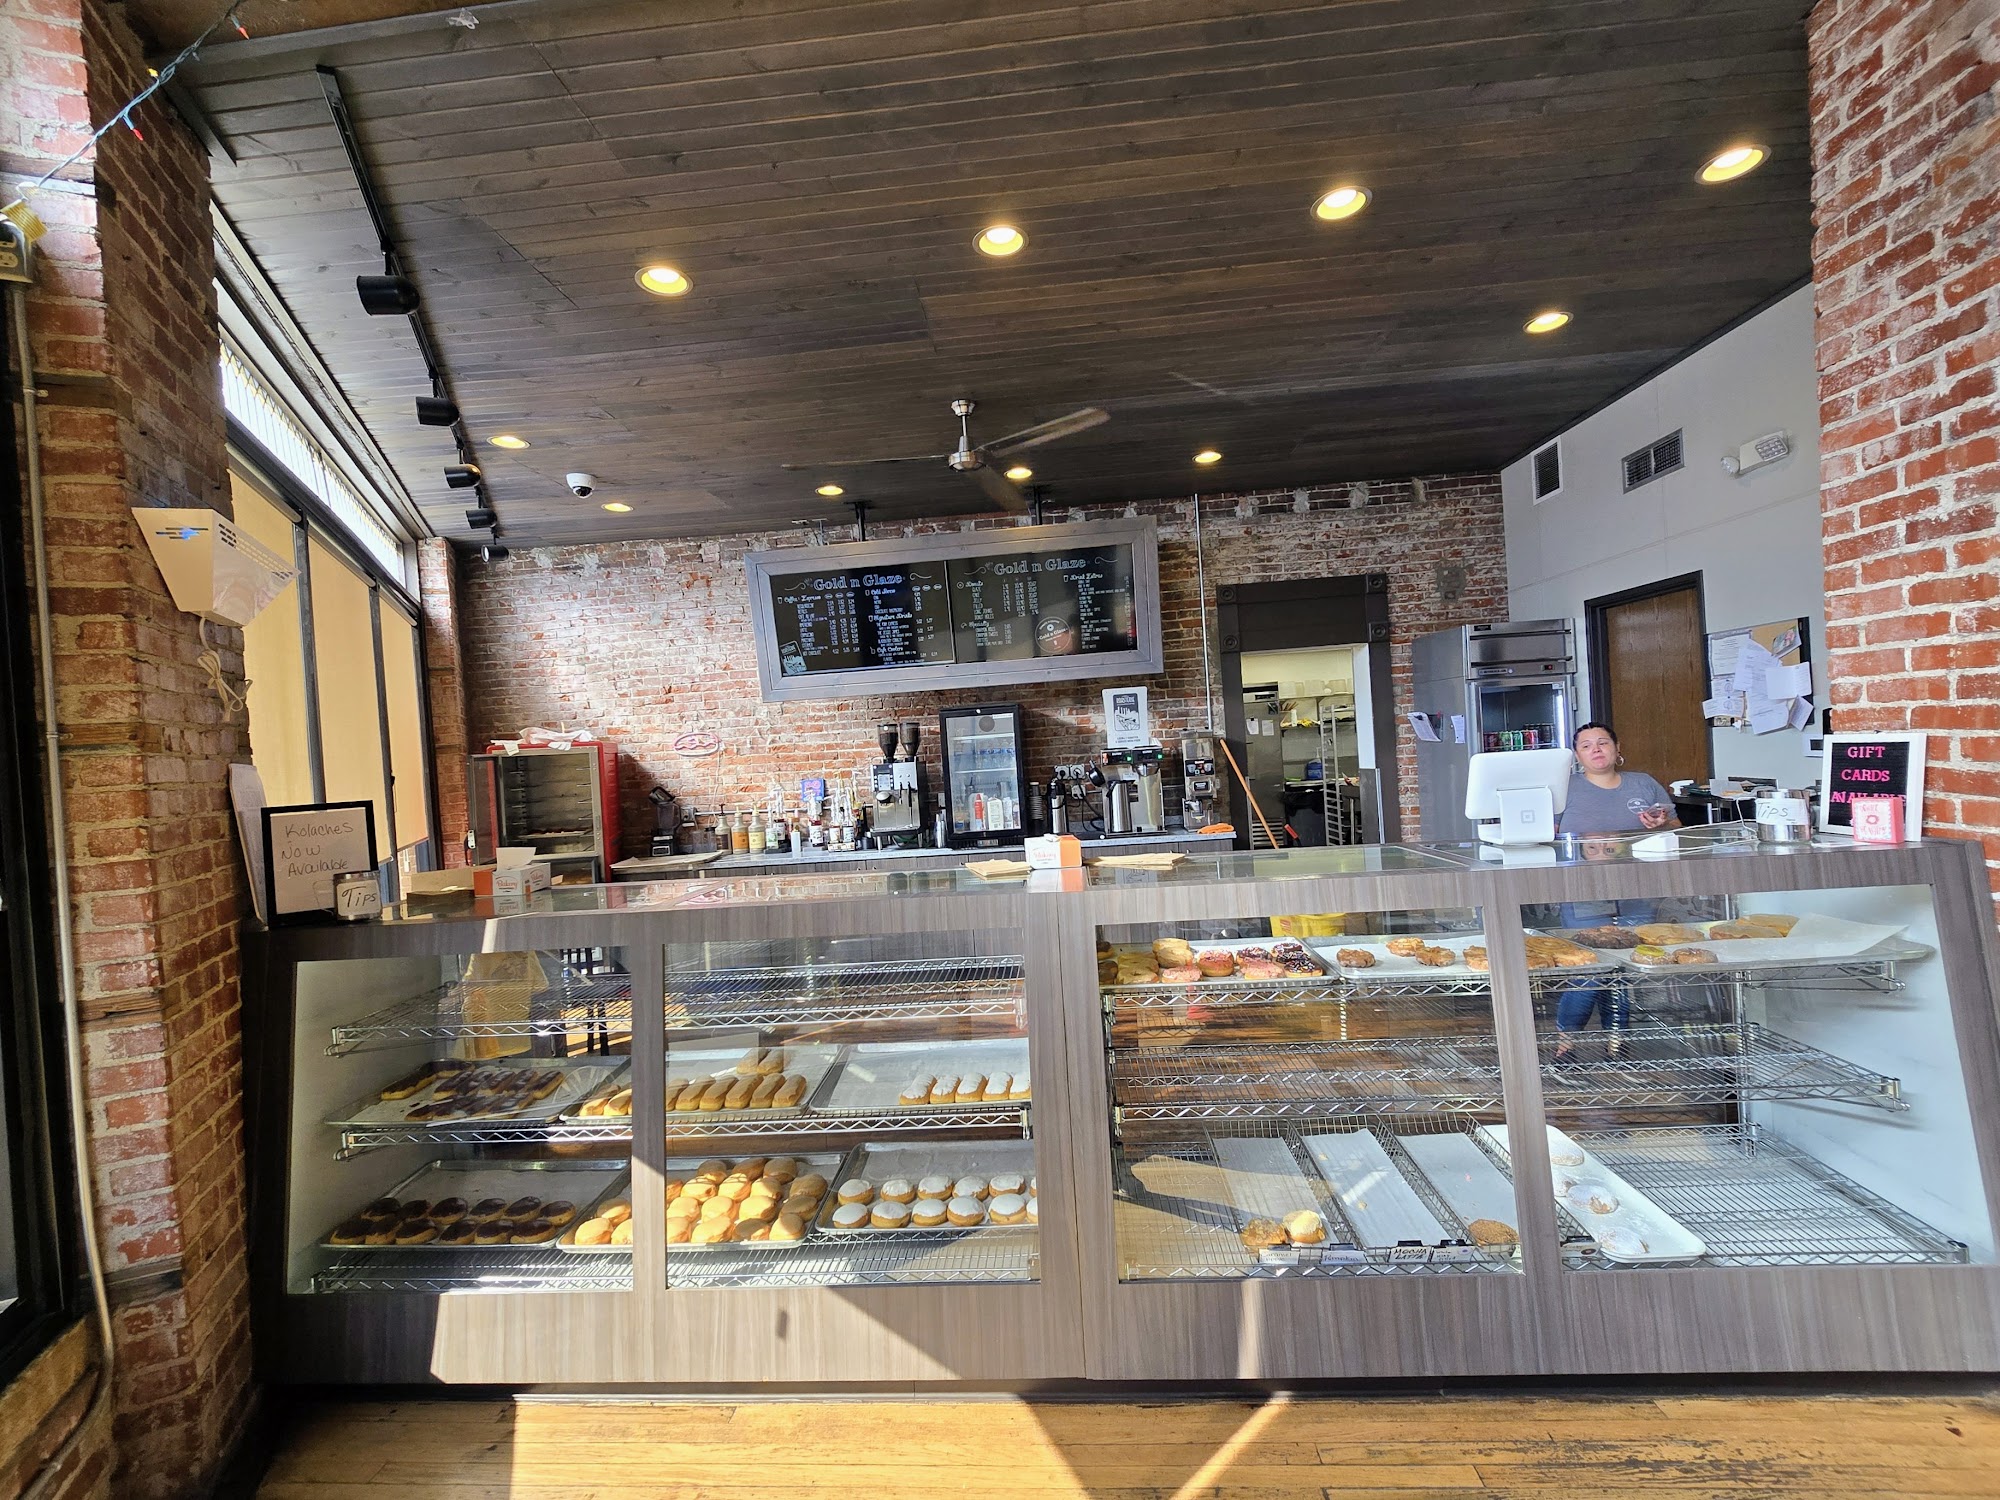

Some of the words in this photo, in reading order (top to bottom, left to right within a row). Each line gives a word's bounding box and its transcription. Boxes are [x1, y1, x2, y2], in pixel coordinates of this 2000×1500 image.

[993, 560, 1029, 576] Gold
[1031, 562, 1043, 573] n
[1045, 558, 1087, 571] Glaze
[813, 575, 848, 591] Gold
[850, 578, 861, 588] n
[862, 573, 903, 587] Glaze
[1847, 746, 1886, 759] GIFT
[1841, 769, 1890, 782] CARDS
[1758, 802, 1789, 819] Tips
[285, 822, 354, 838] Kolaches
[288, 859, 349, 877] Available
[496, 880, 518, 890] Bakery
[341, 886, 377, 908] Tips
